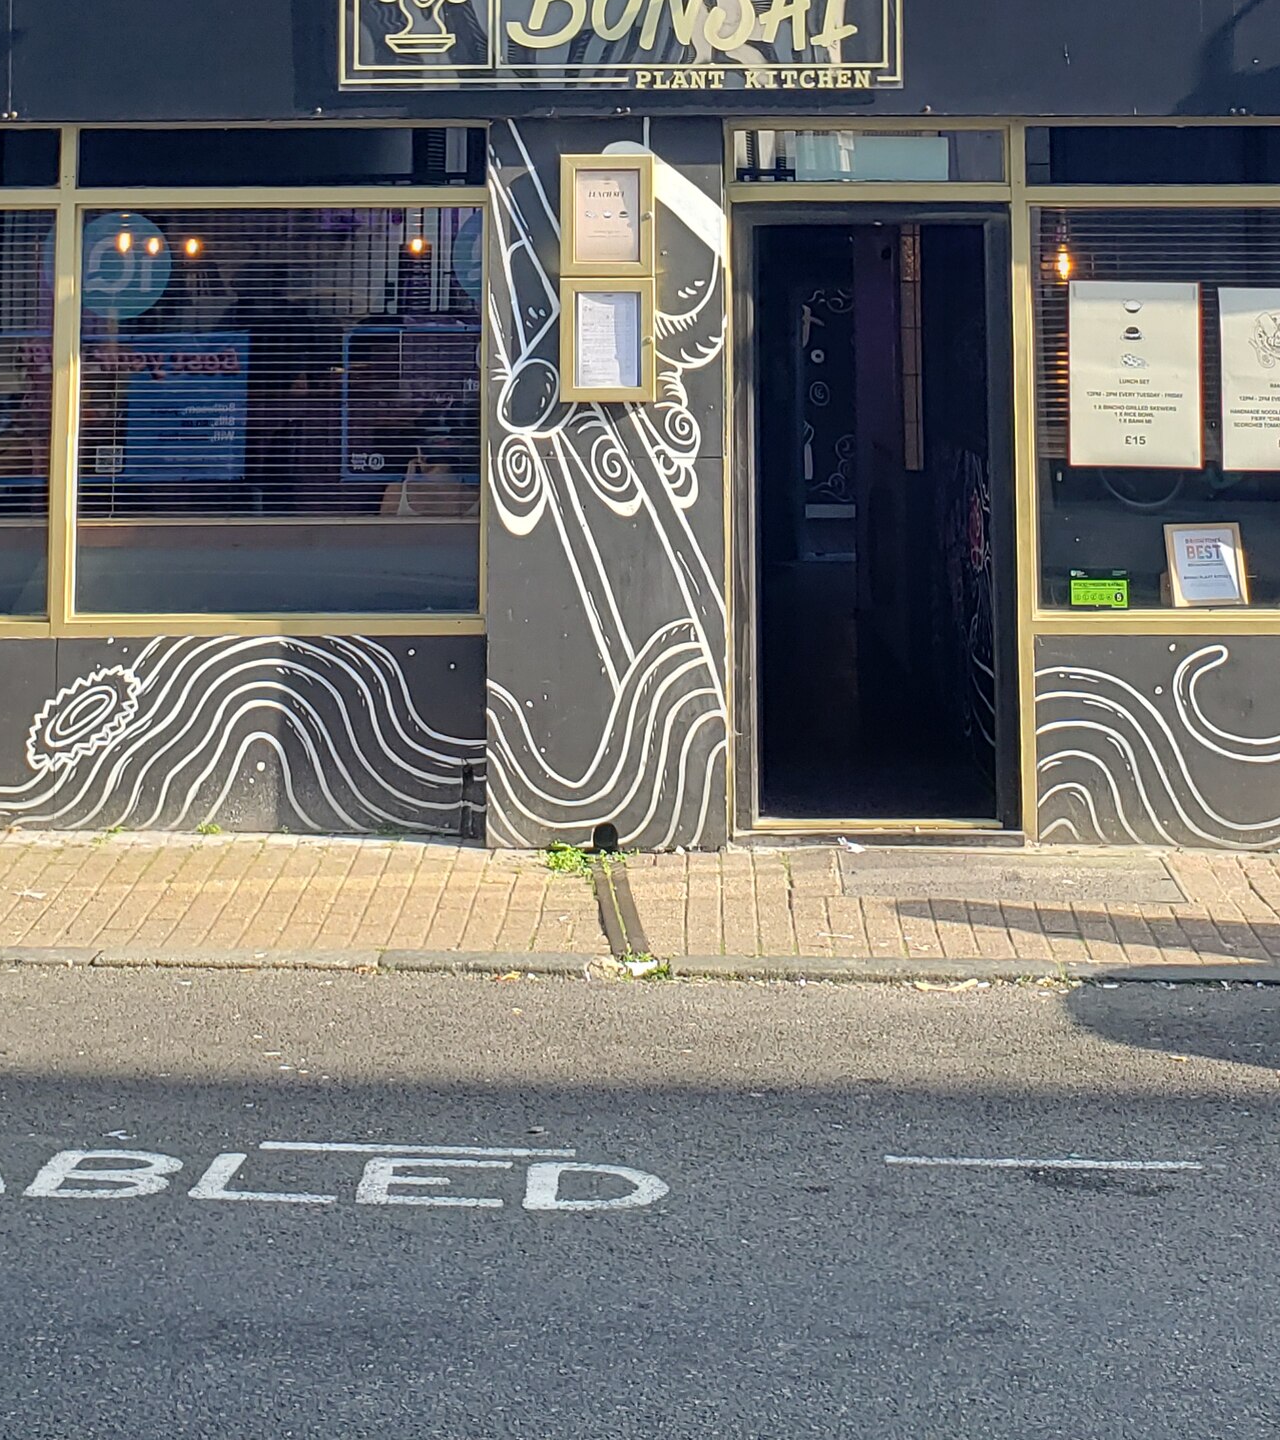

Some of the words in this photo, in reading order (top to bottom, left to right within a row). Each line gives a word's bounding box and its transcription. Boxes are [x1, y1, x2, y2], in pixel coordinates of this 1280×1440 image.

[635, 69, 726, 89] PLANT
[745, 69, 871, 89] KITCHEN
[1125, 435, 1146, 445] £15
[1186, 545, 1222, 559] BEST
